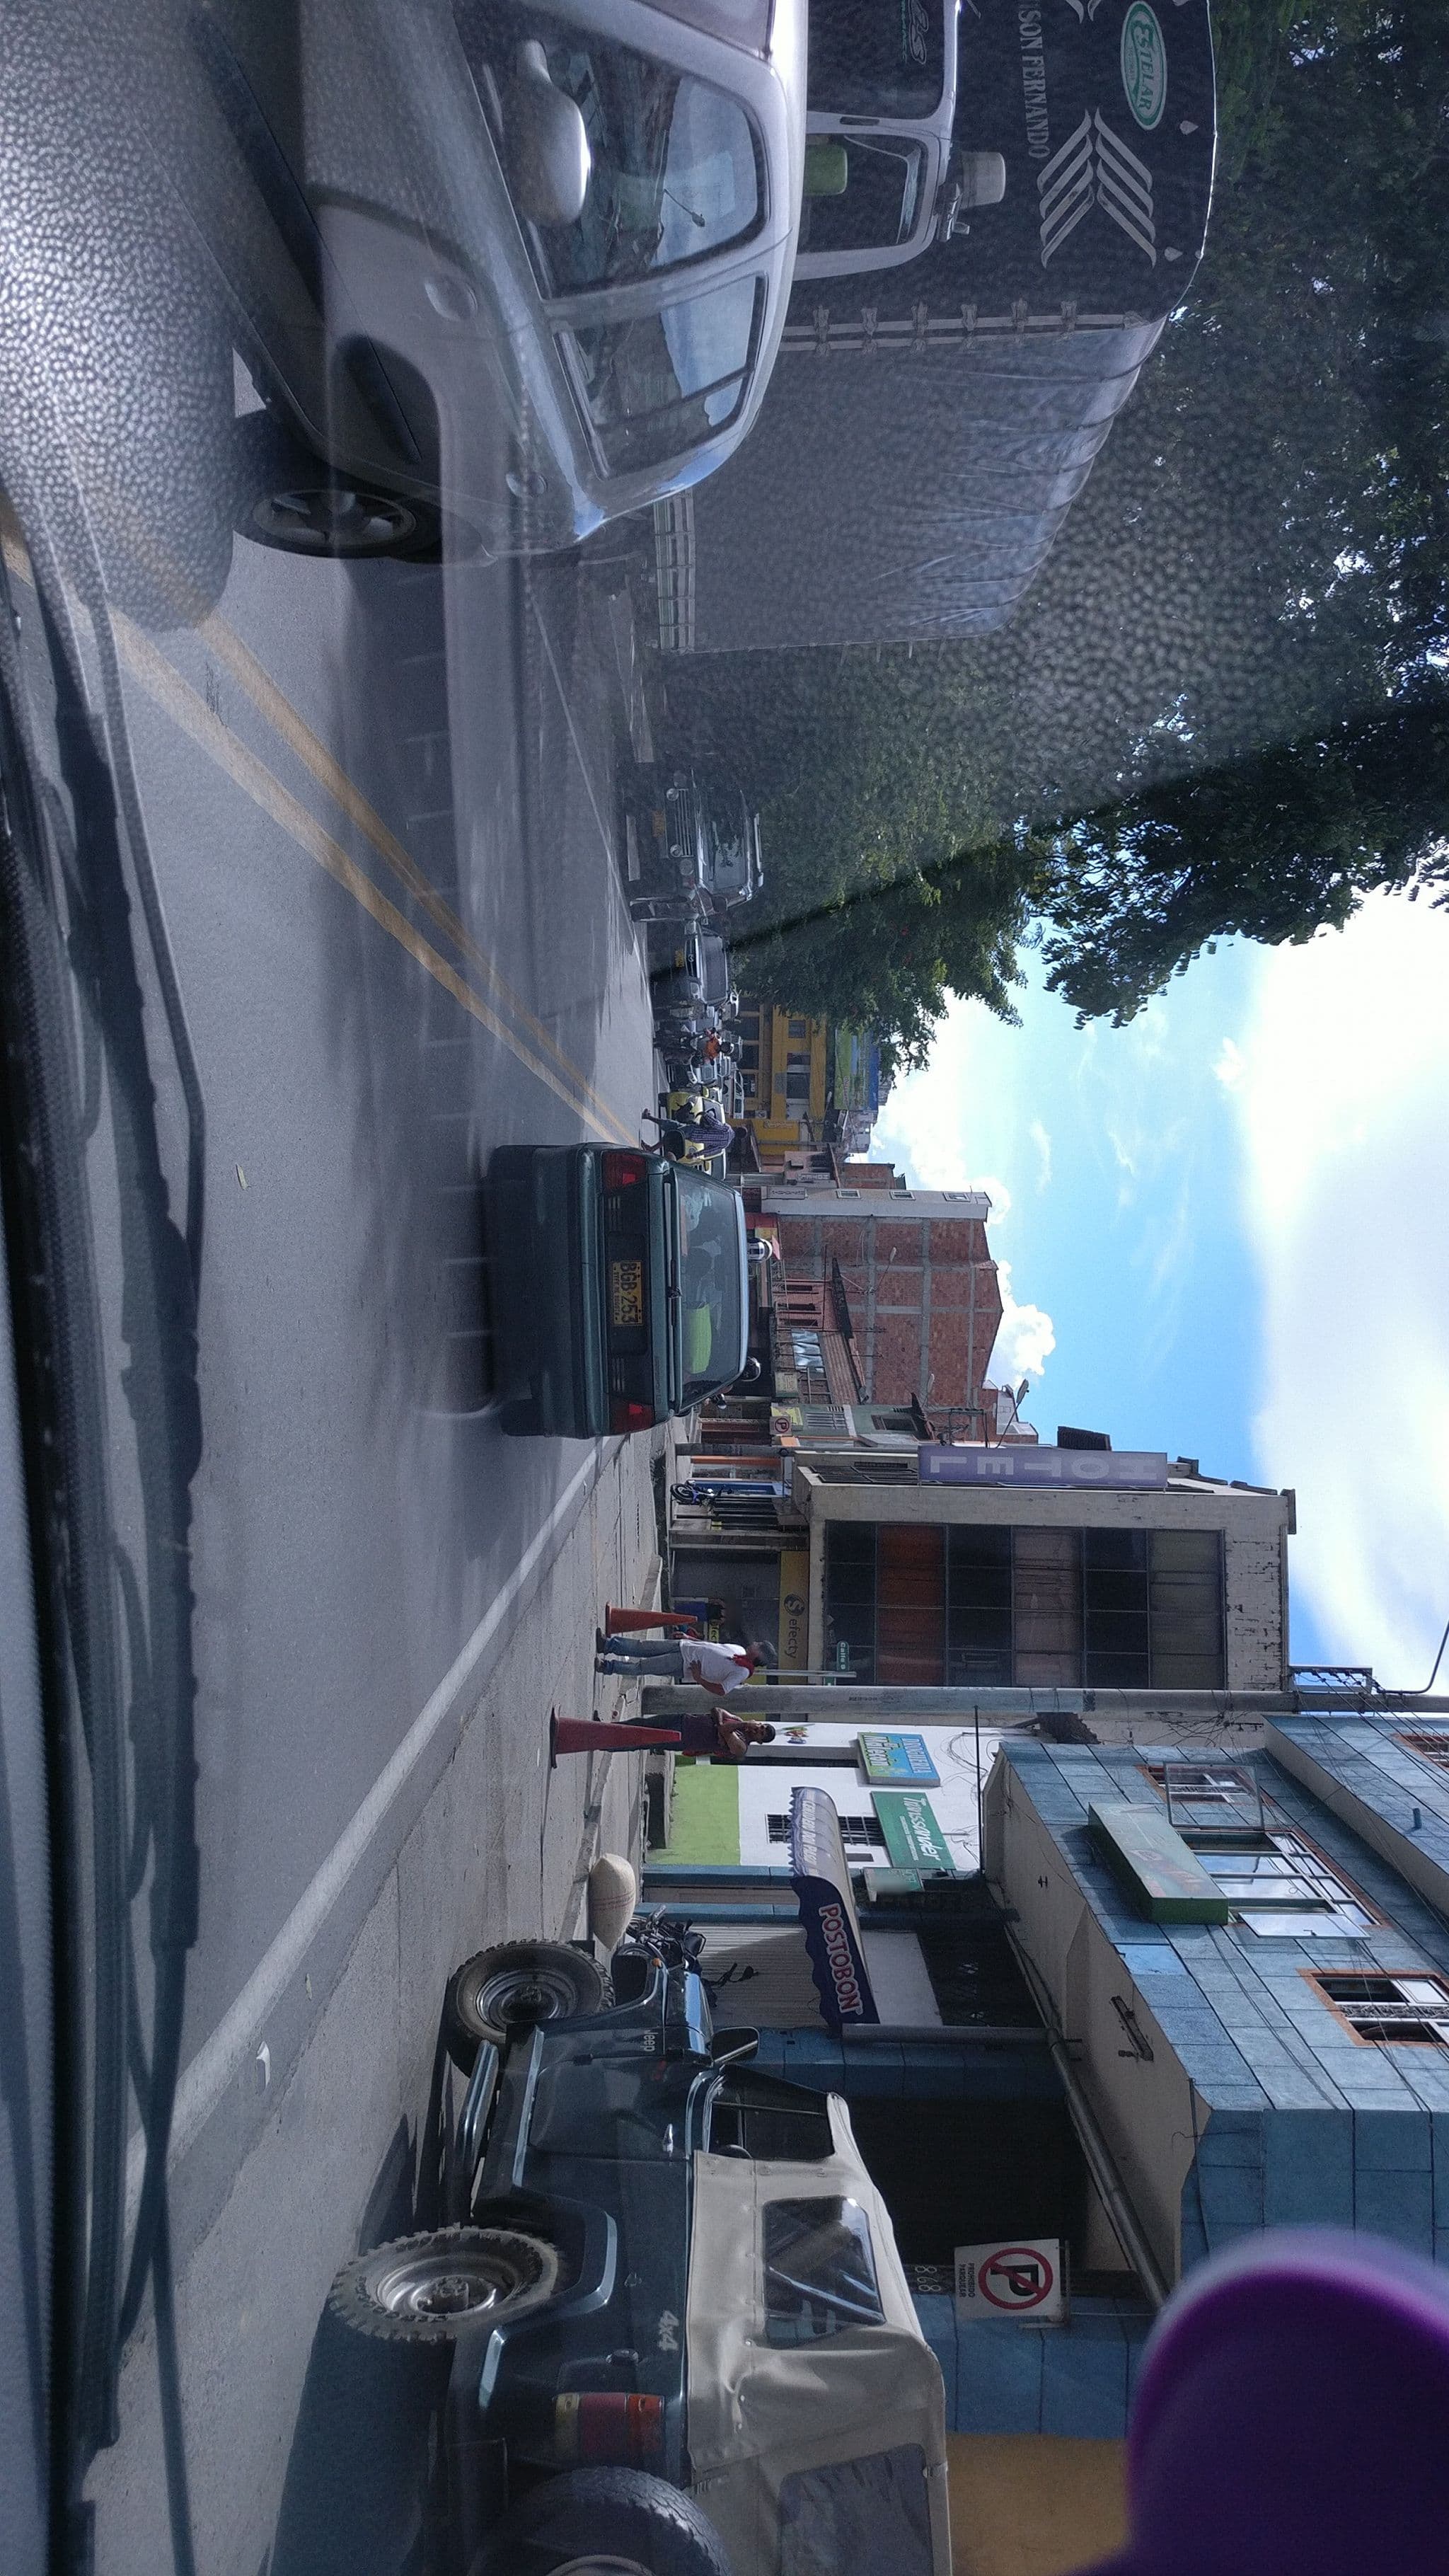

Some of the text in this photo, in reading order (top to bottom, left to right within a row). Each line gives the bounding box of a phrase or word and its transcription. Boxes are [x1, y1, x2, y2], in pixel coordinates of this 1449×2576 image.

[1132, 21, 1155, 110] ESTELAR
[1022, 56, 1051, 159] FERNANDO
[930, 1455, 1158, 1480] HOTEL
[785, 1619, 800, 1658] efecty
[903, 1798, 944, 1861] Transsander
[819, 1904, 861, 2012] POSTOBON
[640, 2030, 659, 2052] Jeep
[959, 2264, 967, 2298] PARQUEAR
[967, 2263, 976, 2298] PROHIBIDO
[659, 2310, 679, 2351] 4x4
